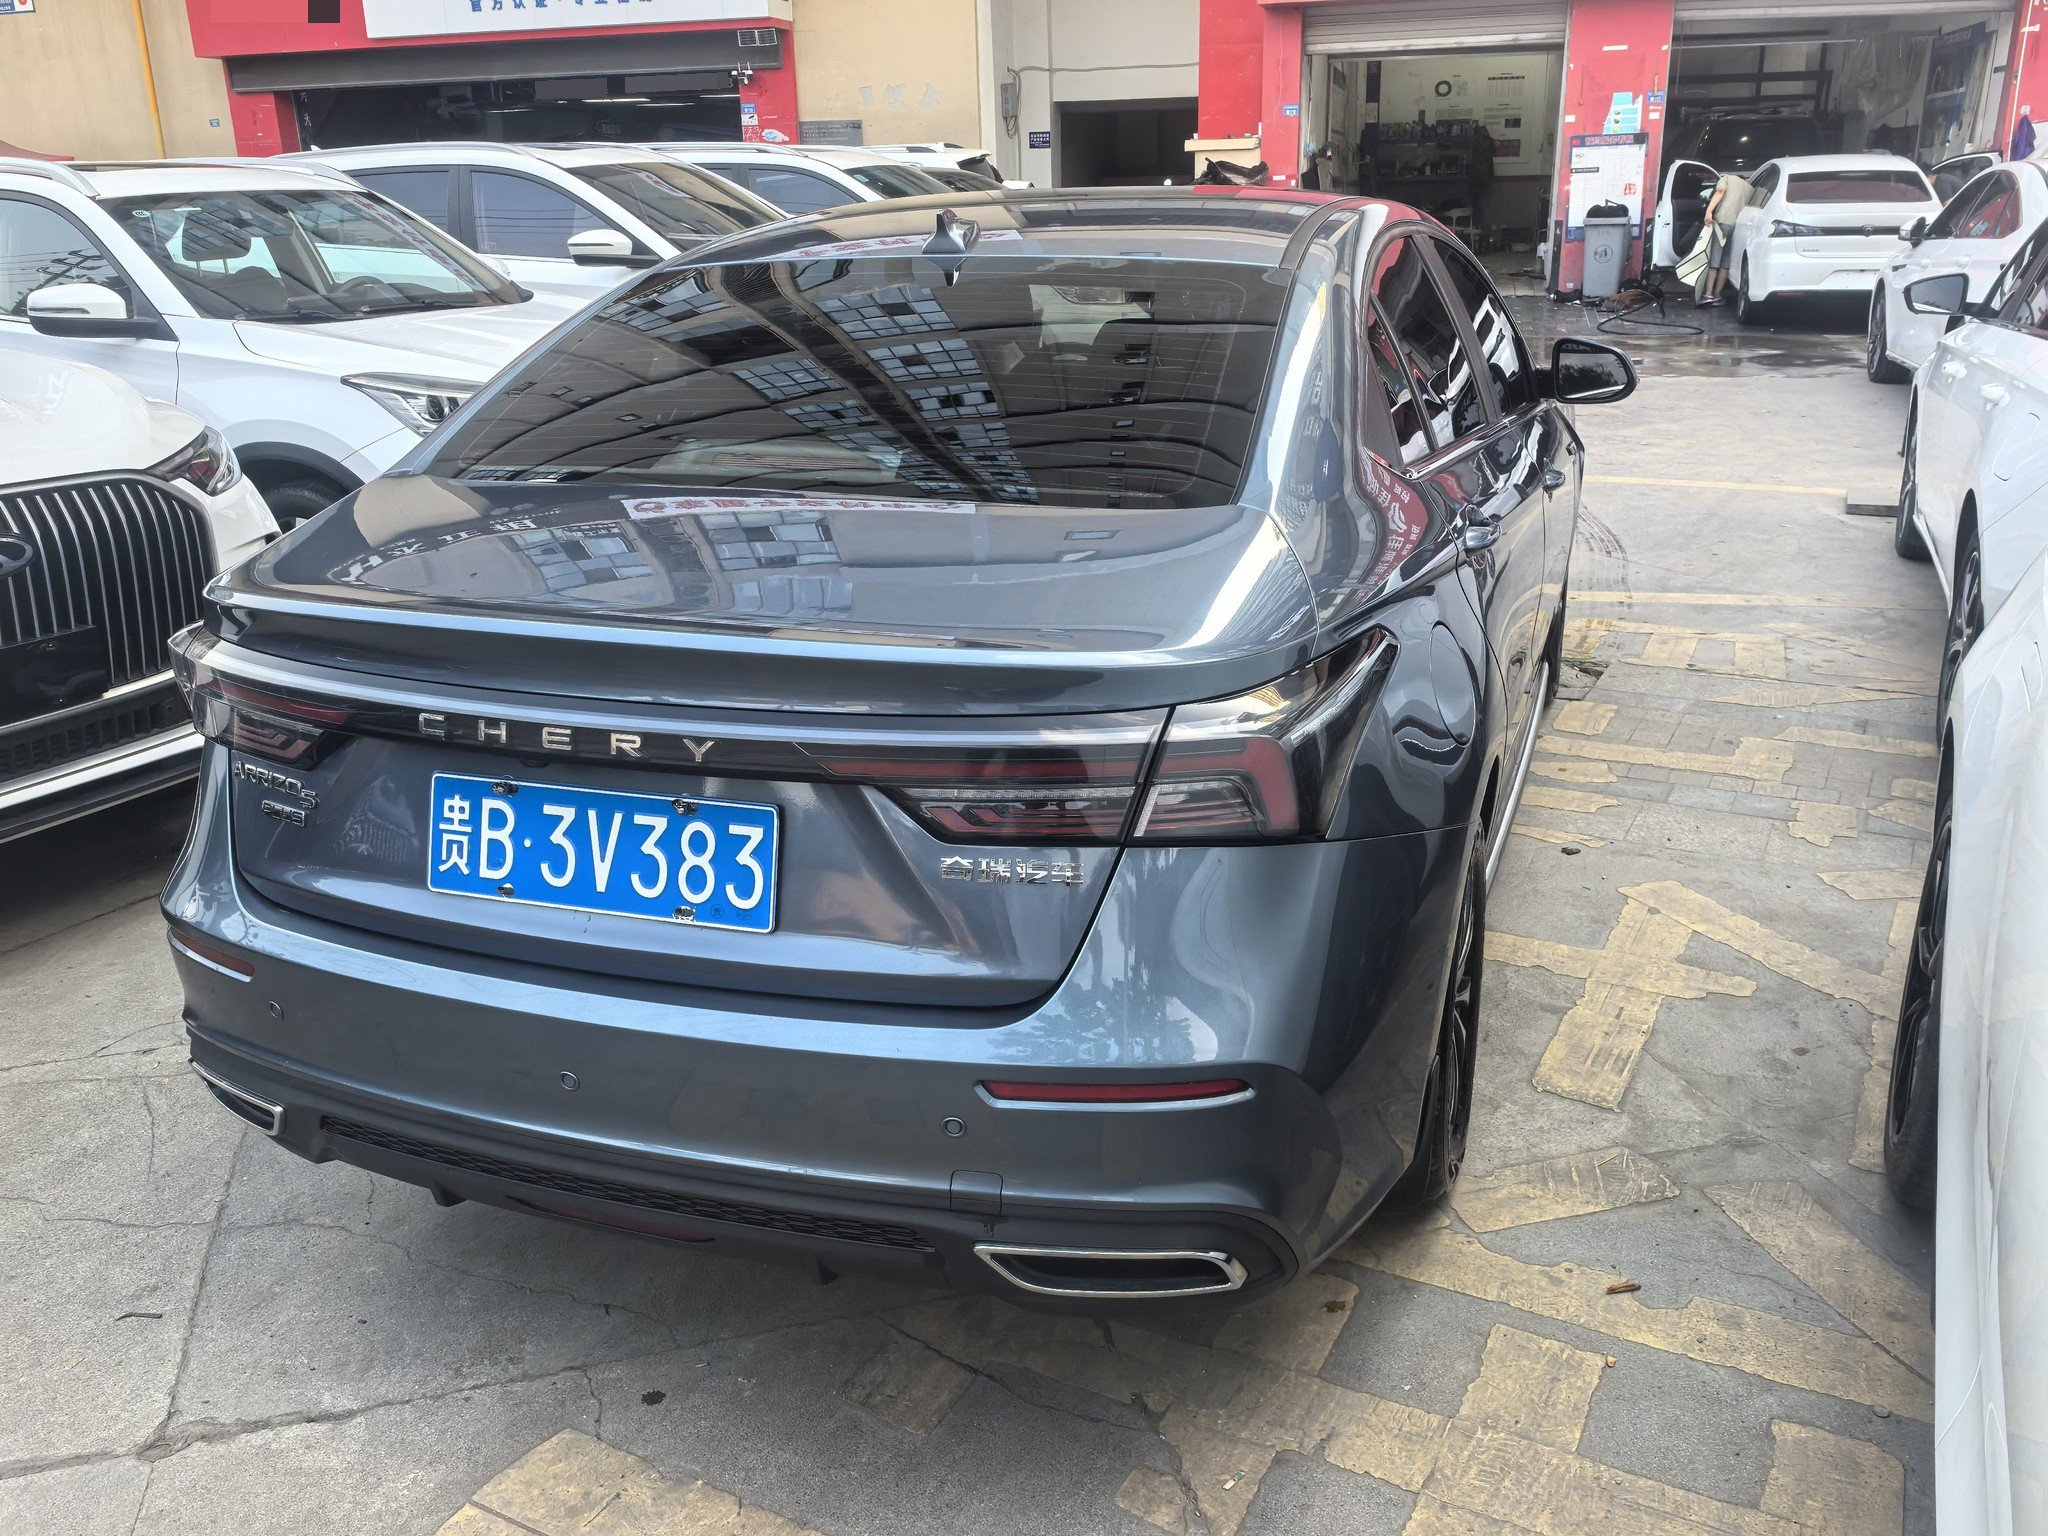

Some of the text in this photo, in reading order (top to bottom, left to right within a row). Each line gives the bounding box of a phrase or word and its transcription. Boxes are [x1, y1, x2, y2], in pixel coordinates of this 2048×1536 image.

[418, 712, 715, 762] CHERY
[438, 795, 765, 911] 贵B·3V383
[940, 855, 1084, 887] 奇瑞汽车
